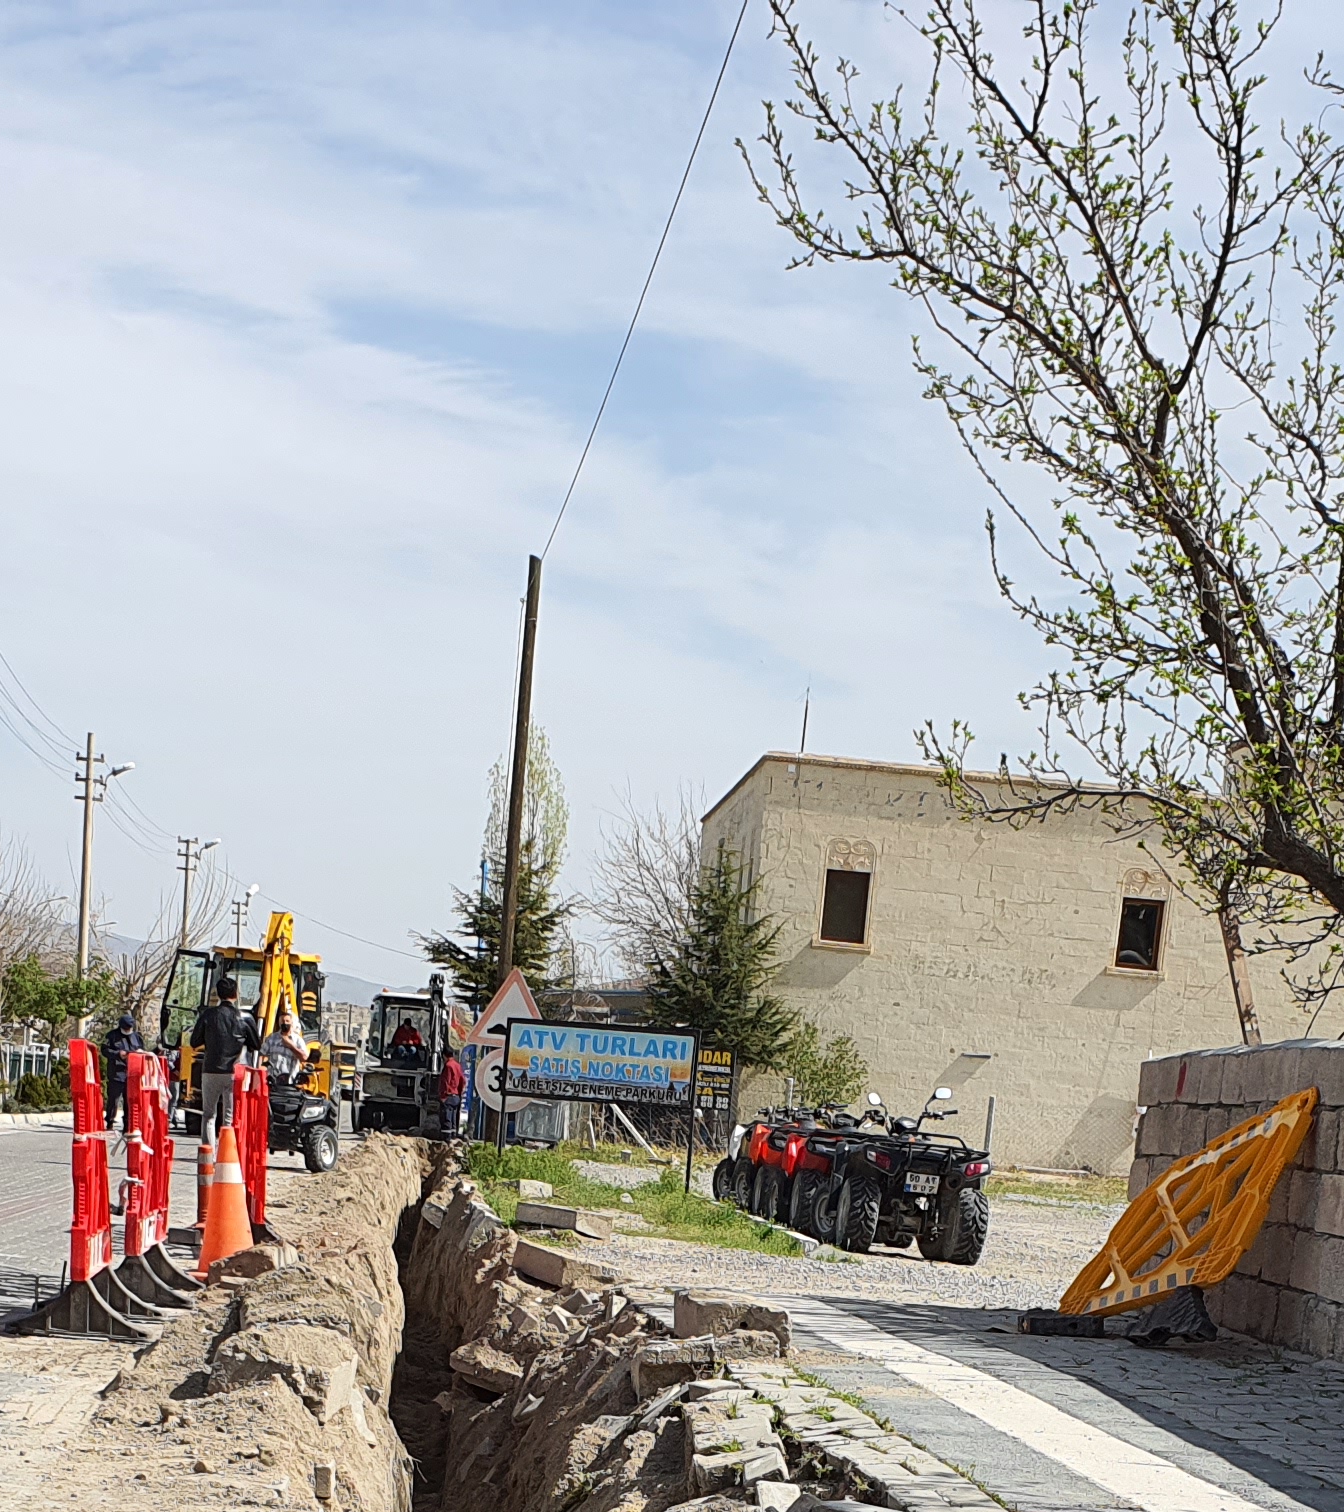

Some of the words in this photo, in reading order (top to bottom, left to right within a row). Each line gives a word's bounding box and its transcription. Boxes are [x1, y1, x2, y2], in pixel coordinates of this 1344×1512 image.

[517, 1029, 567, 1051] ATV
[575, 1033, 687, 1061] TURLARI
[529, 1055, 581, 1080] SATIŞ
[588, 1060, 670, 1083] NOKTASI
[573, 1083, 622, 1097] DENEME
[625, 1087, 682, 1101] PARKURU
